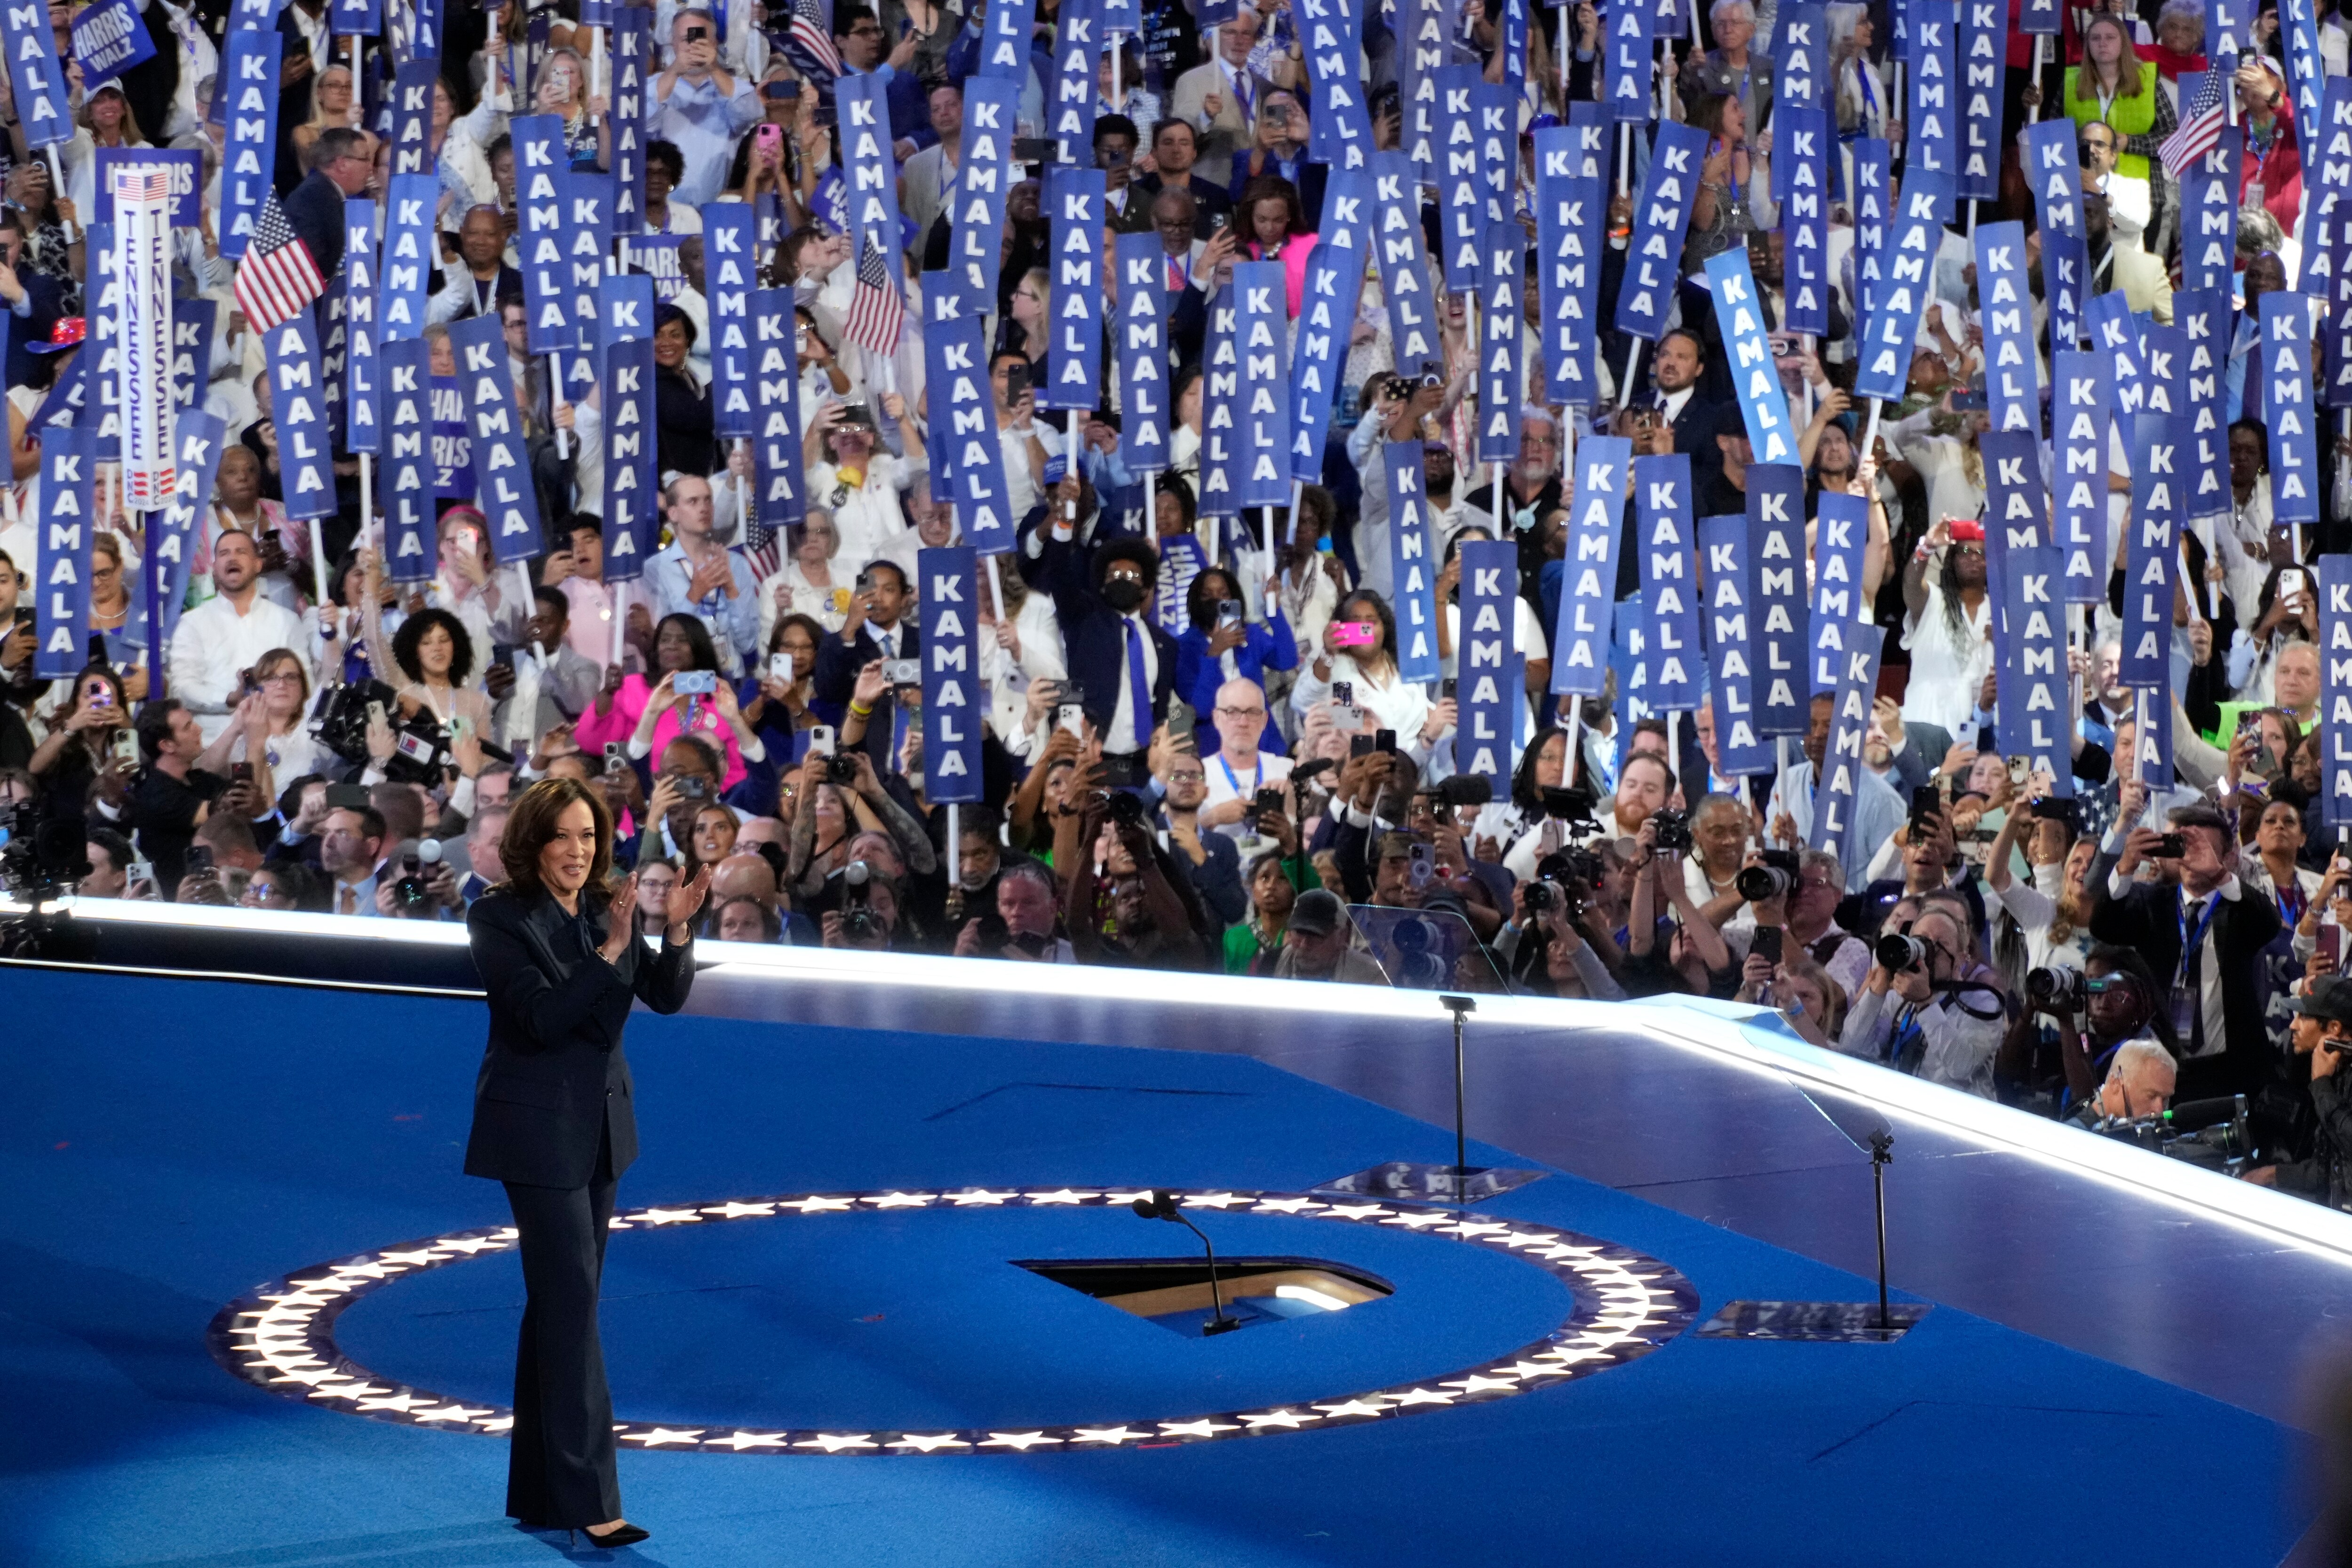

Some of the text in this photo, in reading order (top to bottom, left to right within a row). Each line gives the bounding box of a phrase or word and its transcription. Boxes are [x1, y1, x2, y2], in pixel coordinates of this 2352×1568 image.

[9, 4, 58, 122] MALA
[72, 2, 135, 62] HARRIS
[88, 39, 135, 72] WALZ
[617, 32, 639, 214] KAMALA
[1057, 18, 1091, 164] KAMAL
[1508, 0, 1523, 76] ALA
[1617, 0, 1644, 99] ALA
[1784, 23, 1811, 107] KAM
[1919, 23, 1945, 170] KAMAL
[1965, 4, 1996, 177] KAMALA
[230, 55, 266, 237] KAMALA
[397, 85, 427, 173] KAM
[851, 100, 888, 254] KAMAL
[1447, 89, 1480, 268] KAMALA
[1483, 108, 1505, 222] KAMA
[2042, 143, 2074, 238] KAM
[2201, 149, 2229, 290] KAMA
[2309, 100, 2352, 277] KAMALA
[387, 200, 423, 342] KAMA
[525, 142, 566, 329] KAMALA
[568, 199, 600, 382] KAMALA
[1060, 195, 1091, 385] KAMALA
[1378, 175, 1430, 357] KAMALA
[1556, 202, 1585, 382] KAMALA
[1629, 146, 1691, 318] KAMALA
[1793, 131, 1818, 311] KAMALA
[1860, 162, 1882, 341] KAMAL
[1871, 192, 1936, 377] KAMALA
[2057, 257, 2075, 345] KAM
[124, 210, 143, 461] TENNESSEE
[151, 209, 168, 459] TENNESSEE
[173, 322, 201, 406] KAM
[278, 313, 324, 494] AMALA
[323, 297, 347, 432] KAMA
[350, 227, 373, 425] KAMALA
[715, 228, 750, 413] KAMALA
[757, 314, 794, 501] KAMALA
[1128, 258, 1161, 446] KAMALA
[1206, 308, 1236, 493] KAMALA
[1248, 287, 1278, 481] KAMALA
[1291, 268, 1337, 456] KAMALA
[1488, 250, 1514, 437] KAMALA
[1722, 274, 1788, 461] KAMALA
[1988, 246, 2029, 430] KAMALA
[2101, 318, 2144, 414] KAM
[2187, 313, 2220, 495] KAMALA
[2272, 315, 2306, 499] KAMALA
[392, 365, 424, 557] KAMALA
[464, 342, 530, 537] KAMALA
[613, 366, 641, 557] KAMALA
[945, 343, 1000, 532] KAMALA
[1998, 456, 2038, 548] KAM
[2066, 378, 2097, 578] KAMALA
[47, 455, 81, 653] KAMALA
[138, 436, 210, 629] KAMAL
[1156, 558, 1176, 627] WALZ
[1398, 467, 1429, 658] KAMALA
[1567, 463, 1614, 668] KAMALA
[1650, 482, 1688, 685] KAMALA
[1761, 493, 1796, 706] KAMALA
[1817, 519, 1851, 685] KAMAL
[2135, 445, 2174, 659] KAMALA
[933, 575, 968, 777] KAMALA
[1470, 568, 1502, 775] KAMALA
[1629, 628, 1649, 723] KAM
[1710, 543, 1757, 749] KAMALA
[2022, 574, 2057, 783] KAMALA
[2331, 584, 2352, 797] KAMALA
[2265, 954, 2290, 1056] KAM
